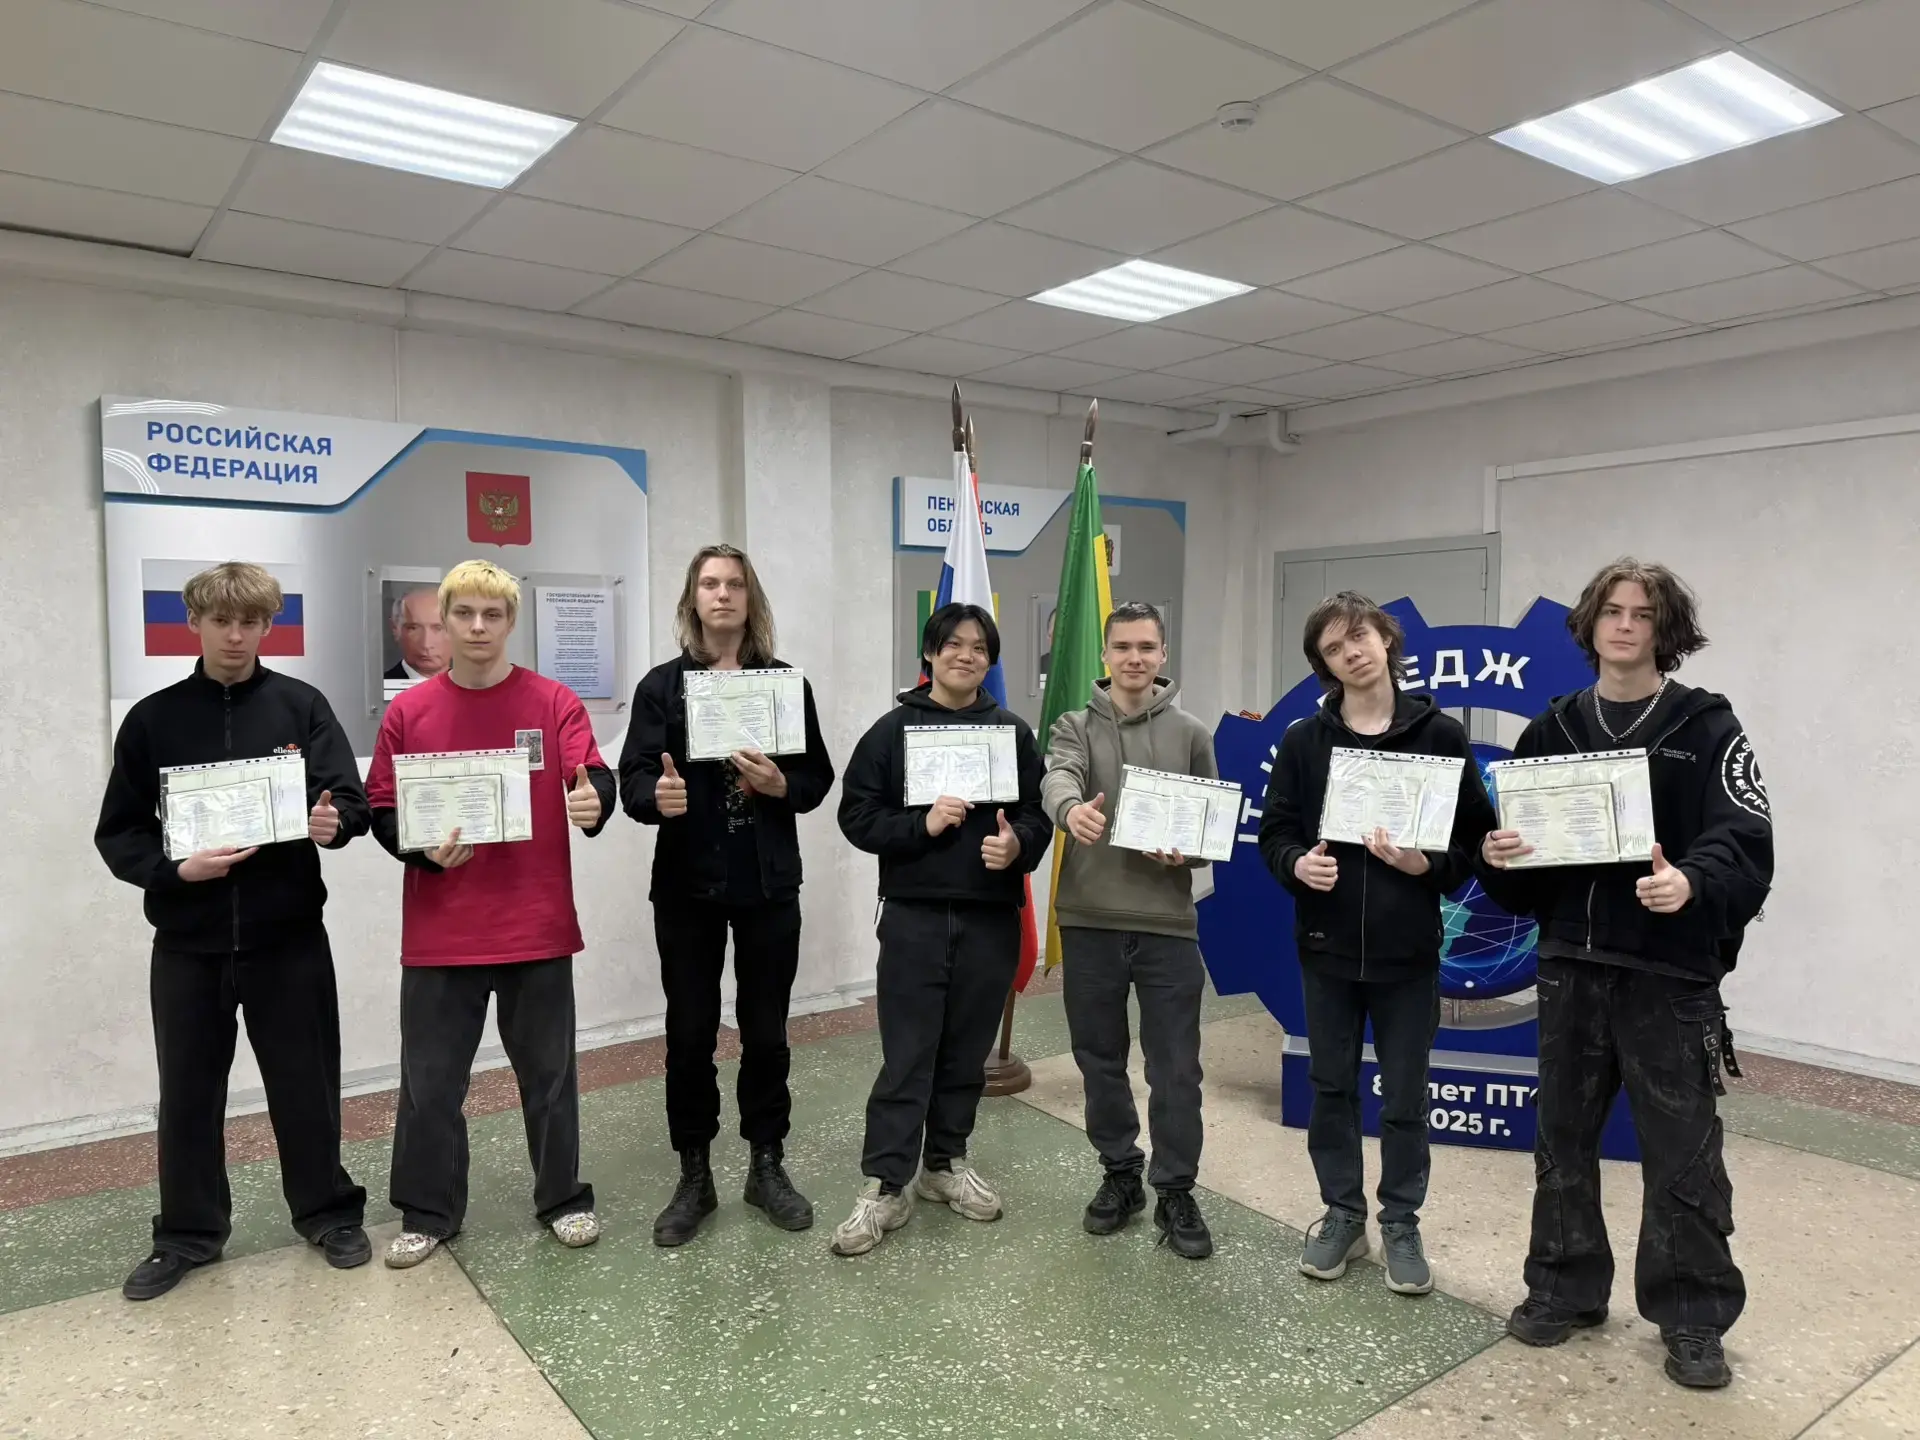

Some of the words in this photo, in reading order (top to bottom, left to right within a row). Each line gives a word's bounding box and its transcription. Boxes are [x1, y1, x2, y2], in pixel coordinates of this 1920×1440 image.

[147, 421, 332, 456] РОССИЙСКАЯ
[147, 453, 318, 485] ФЕДЕРАЦИЯ
[273, 746, 302, 755] ellesse
[1427, 1108, 1484, 1135] 025
[1490, 1118, 1512, 1137] г.
